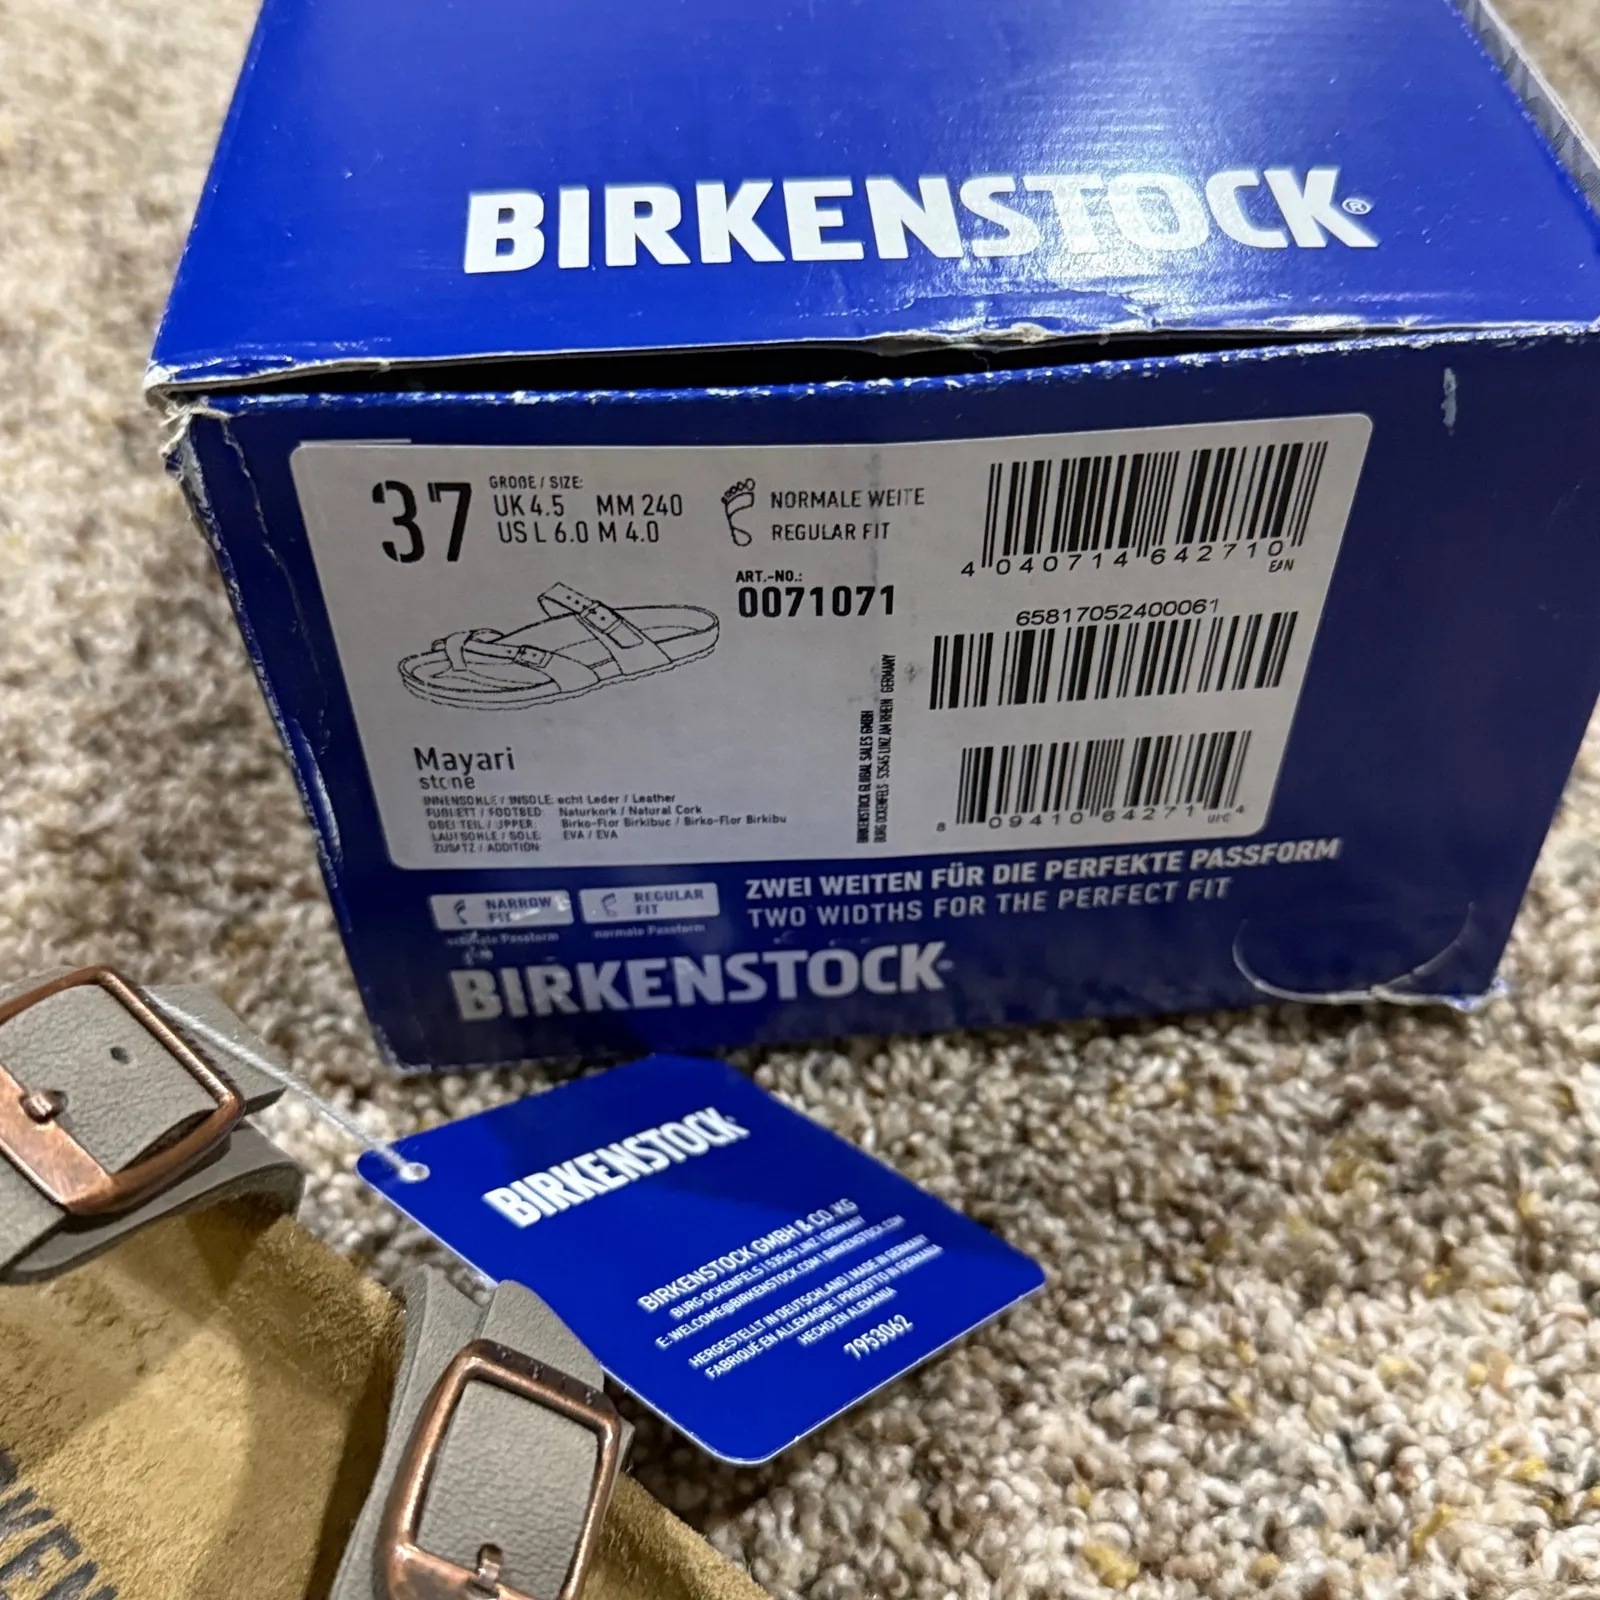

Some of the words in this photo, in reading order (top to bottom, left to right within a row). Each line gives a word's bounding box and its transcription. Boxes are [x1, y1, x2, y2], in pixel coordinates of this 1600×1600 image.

[494, 494, 525, 517] UK
[530, 494, 565, 517] 4.5
[596, 494, 635, 517] MM
[641, 494, 683, 517] 240
[771, 489, 862, 509] NORMALE
[868, 487, 925, 507] WEITE
[371, 480, 472, 563] 37
[497, 521, 529, 544] US
[534, 521, 548, 544] L
[553, 521, 589, 543] 6.0
[598, 521, 618, 543] M
[625, 521, 660, 543] 4.0
[772, 523, 856, 541] REGULAR
[862, 522, 891, 540] FIT
[738, 584, 895, 618] 0071071
[1016, 598, 1219, 627] 65817052400061
[880, 654, 897, 693] GERMANY
[413, 746, 516, 776] Mayari
[859, 736, 873, 762] SALES
[419, 774, 476, 790] stone
[557, 795, 583, 805] echt
[587, 794, 620, 804] Leder
[632, 793, 676, 804] Leather
[559, 806, 617, 817] Naturkork
[628, 806, 672, 816] Natural
[675, 805, 702, 815] Cork
[561, 818, 619, 829] Birko-Flor
[683, 816, 742, 827] Birko-Flor
[746, 814, 788, 825] Birkibu
[562, 830, 585, 841] EVA
[596, 829, 618, 840] EVA
[745, 877, 812, 900] ZWEI
[819, 871, 923, 896] WEITEN
[931, 862, 984, 890] FÜR
[992, 862, 1037, 885] DIE
[1044, 850, 1184, 881] PERFEKTE
[1190, 837, 1342, 870] PASSFORM
[485, 896, 552, 910] NARROW
[633, 889, 705, 903] REGULAR
[747, 906, 807, 928] TWO
[816, 900, 923, 926] WIDTHS
[933, 895, 986, 918] FOR
[996, 890, 1048, 914] THE
[1058, 881, 1179, 910] PERFECT
[1187, 877, 1232, 900] FIT
[635, 904, 659, 916] FIT
[637, 1246, 758, 1313] BIRKENSTOCK
[750, 1224, 802, 1256] GMBH
[794, 1219, 815, 1235] &
[669, 1297, 704, 1319] BURG
[701, 1265, 764, 1304] OCKENFELS
[688, 1319, 766, 1369] HERGESTELLT
[763, 1313, 780, 1328] IN
[774, 1275, 849, 1321] DEUTSCHLAND
[848, 1258, 880, 1280] MADE
[704, 1340, 764, 1380] FABRIQUÉ
[758, 1333, 779, 1349] EN
[775, 1299, 838, 1341] ALLEMAGNE
[837, 1271, 890, 1303] PRODOTTO
[797, 1319, 836, 1347] HECHO
[831, 1311, 850, 1328] EN
[846, 1286, 898, 1318] ALEMANIA
[843, 1314, 914, 1361] 7953062
